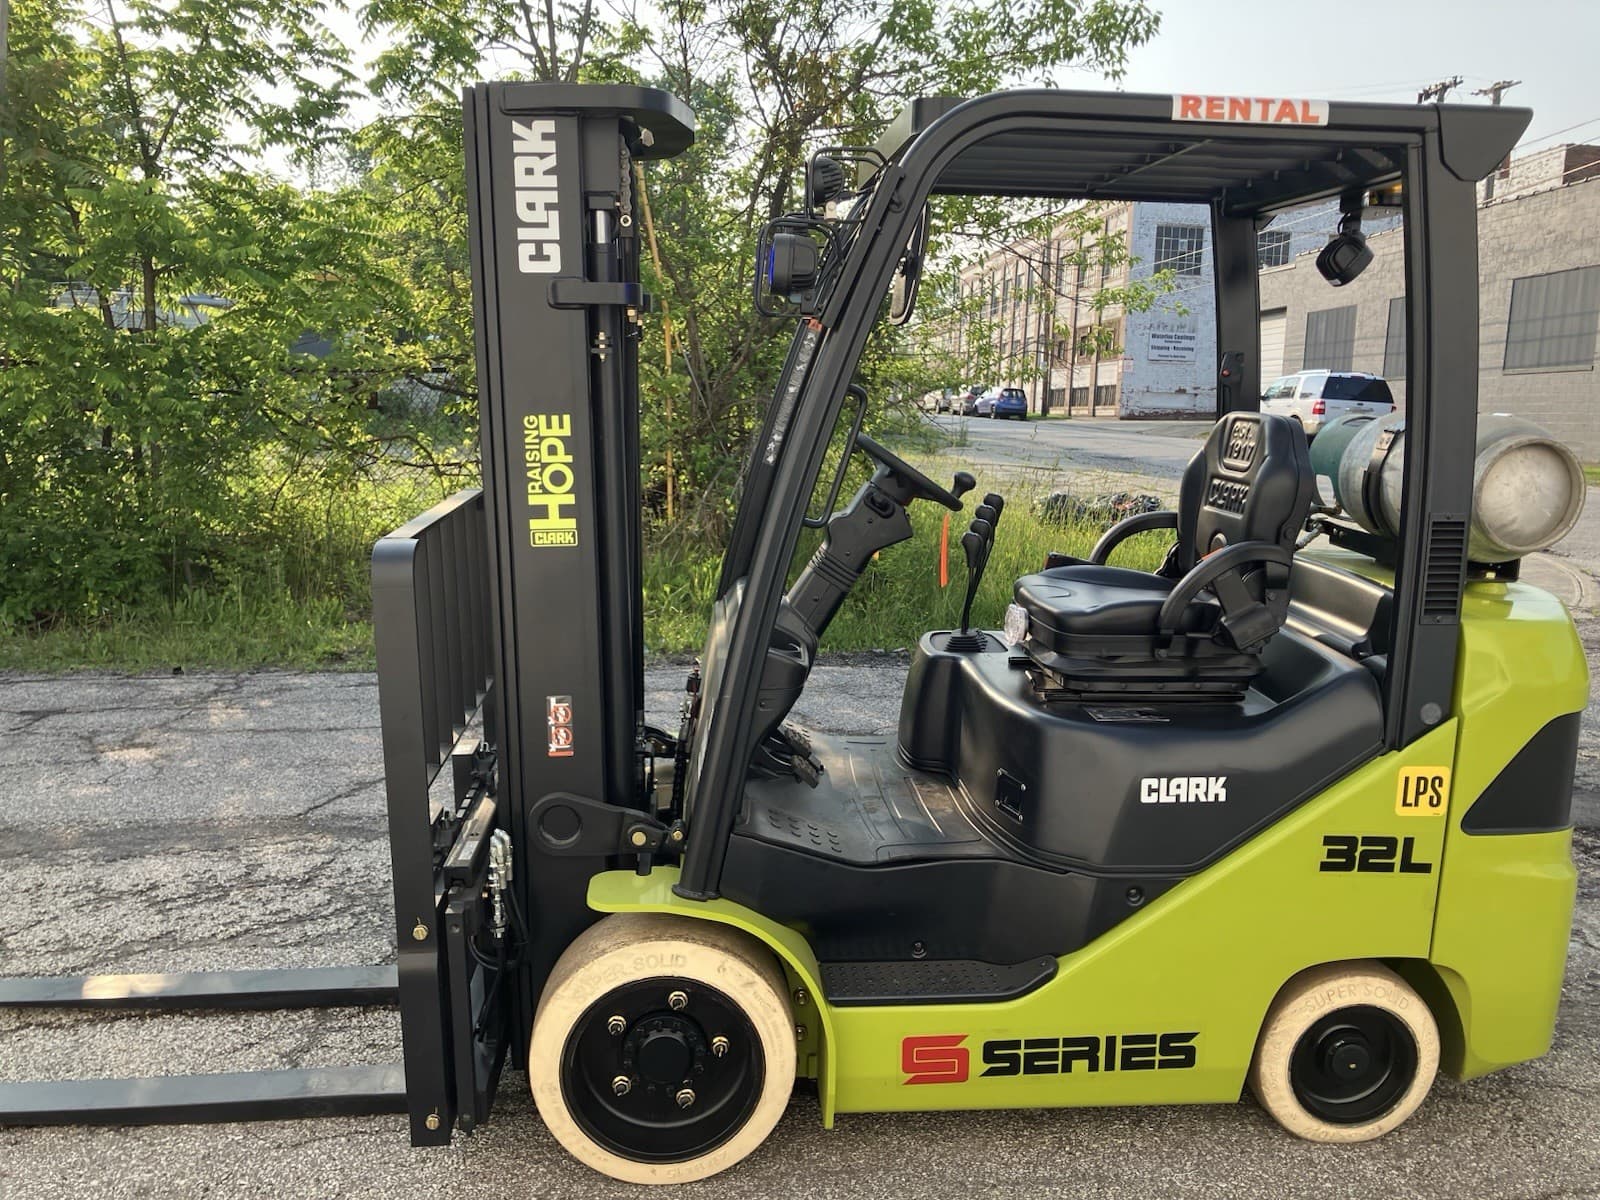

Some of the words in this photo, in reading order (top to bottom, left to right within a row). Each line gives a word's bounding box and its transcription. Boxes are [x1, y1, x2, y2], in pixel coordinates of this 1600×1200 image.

[1179, 95, 1320, 124] RENTAL
[511, 119, 562, 274] CLARK
[523, 414, 543, 494] RAISING
[1228, 439, 1256, 461] 1917
[528, 414, 577, 530] HOPE
[534, 531, 575, 545] CLARK
[1140, 776, 1228, 804] CLARK
[1401, 775, 1444, 808] LPS
[1319, 835, 1433, 874] 32L
[633, 952, 688, 971] SOLID
[1305, 983, 1358, 1012] SUPER
[1363, 982, 1409, 1010] SOLID
[901, 1034, 970, 1086] S
[978, 1031, 1201, 1078] SERIES
